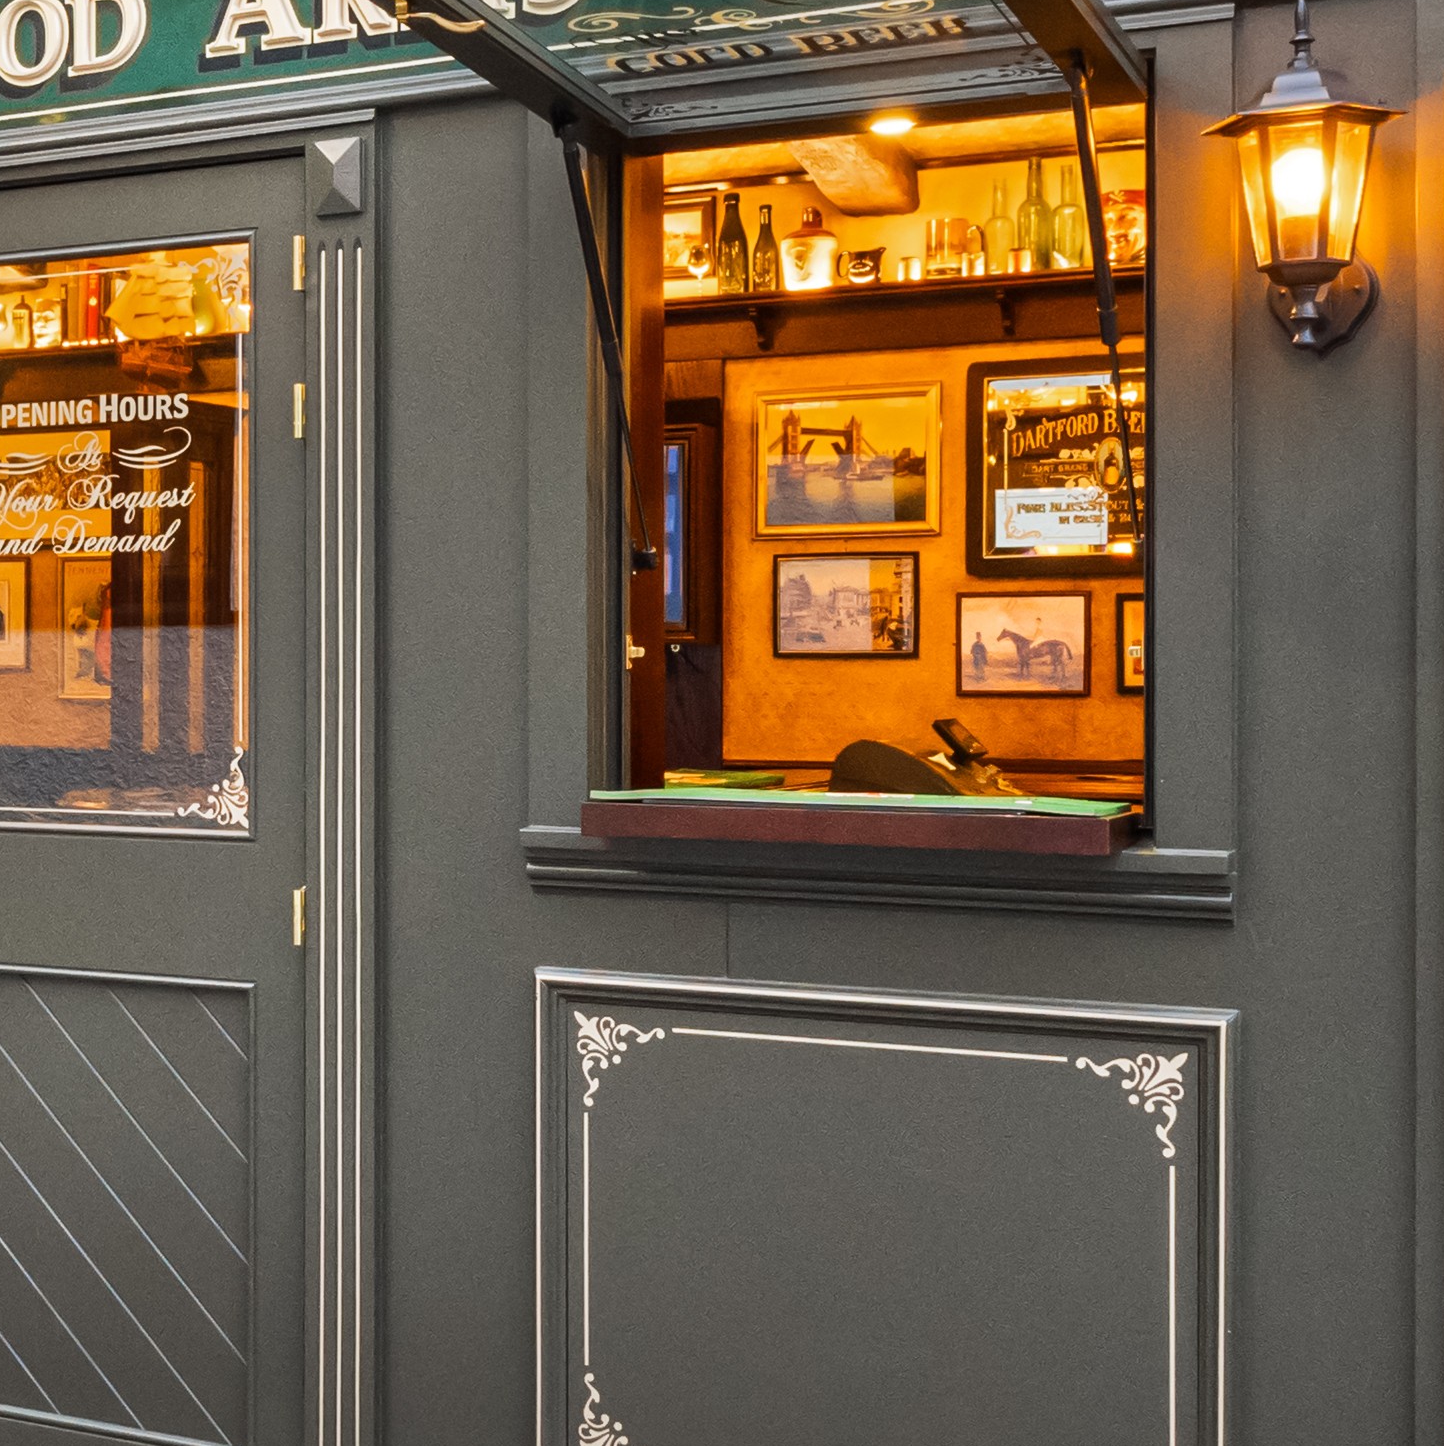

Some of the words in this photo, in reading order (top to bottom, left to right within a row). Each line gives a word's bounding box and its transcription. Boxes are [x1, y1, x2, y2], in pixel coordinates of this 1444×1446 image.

[99, 393, 189, 423] HOURS
[57, 431, 103, 474] At
[1012, 412, 1099, 456] DARTFORD
[67, 474, 196, 524] Request
[52, 515, 181, 555] Demand
